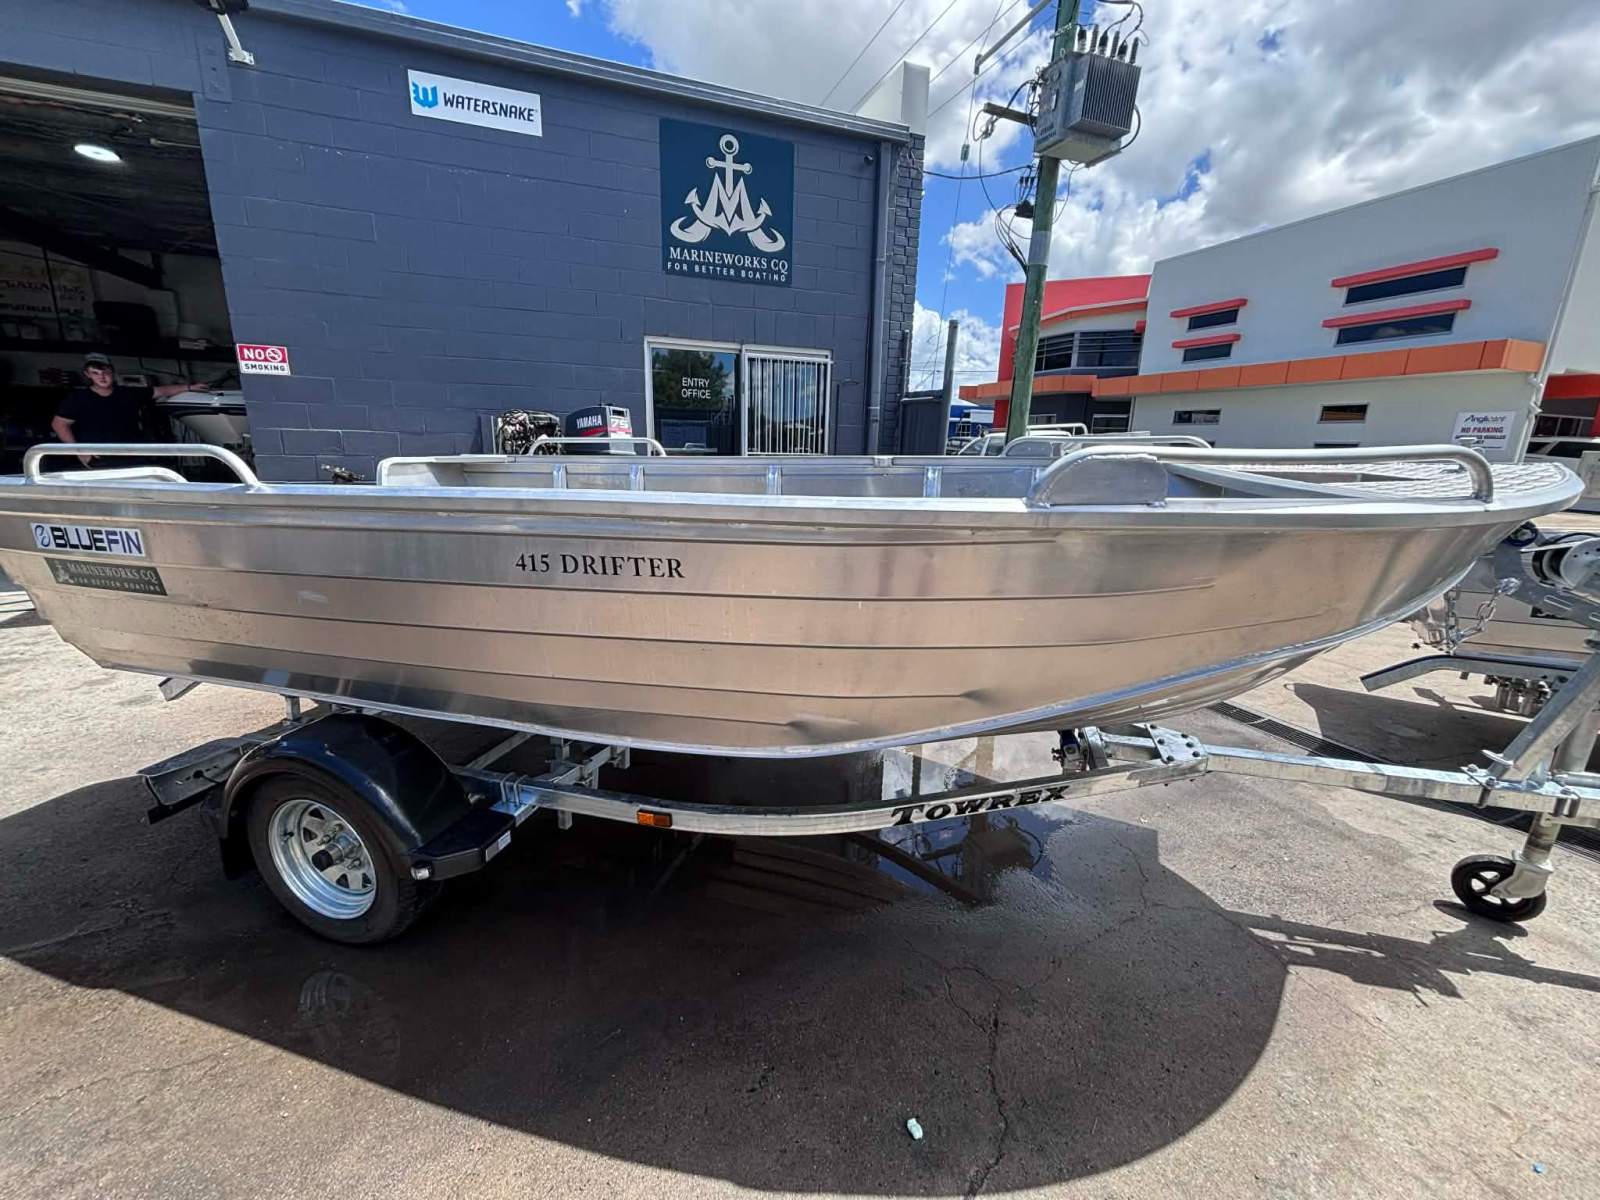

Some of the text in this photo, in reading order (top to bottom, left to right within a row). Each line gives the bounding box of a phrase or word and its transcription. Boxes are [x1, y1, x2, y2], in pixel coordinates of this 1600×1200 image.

[443, 91, 535, 122] WATERSNAKE
[669, 246, 789, 274] MARINEWORKS CQ
[667, 261, 786, 282] FOR BETTER BOATING
[243, 347, 265, 361] NO
[244, 363, 286, 372] SMOKING
[681, 377, 710, 388] ENTRY
[681, 388, 712, 399] OFFICE
[576, 414, 603, 430] YAMAHA
[610, 418, 630, 430] 75
[1472, 426, 1504, 434] PARKING
[50, 526, 143, 554] BLUEFIN
[67, 563, 140, 580] MARINEWORKS
[515, 553, 686, 579] 415 DRIFTER
